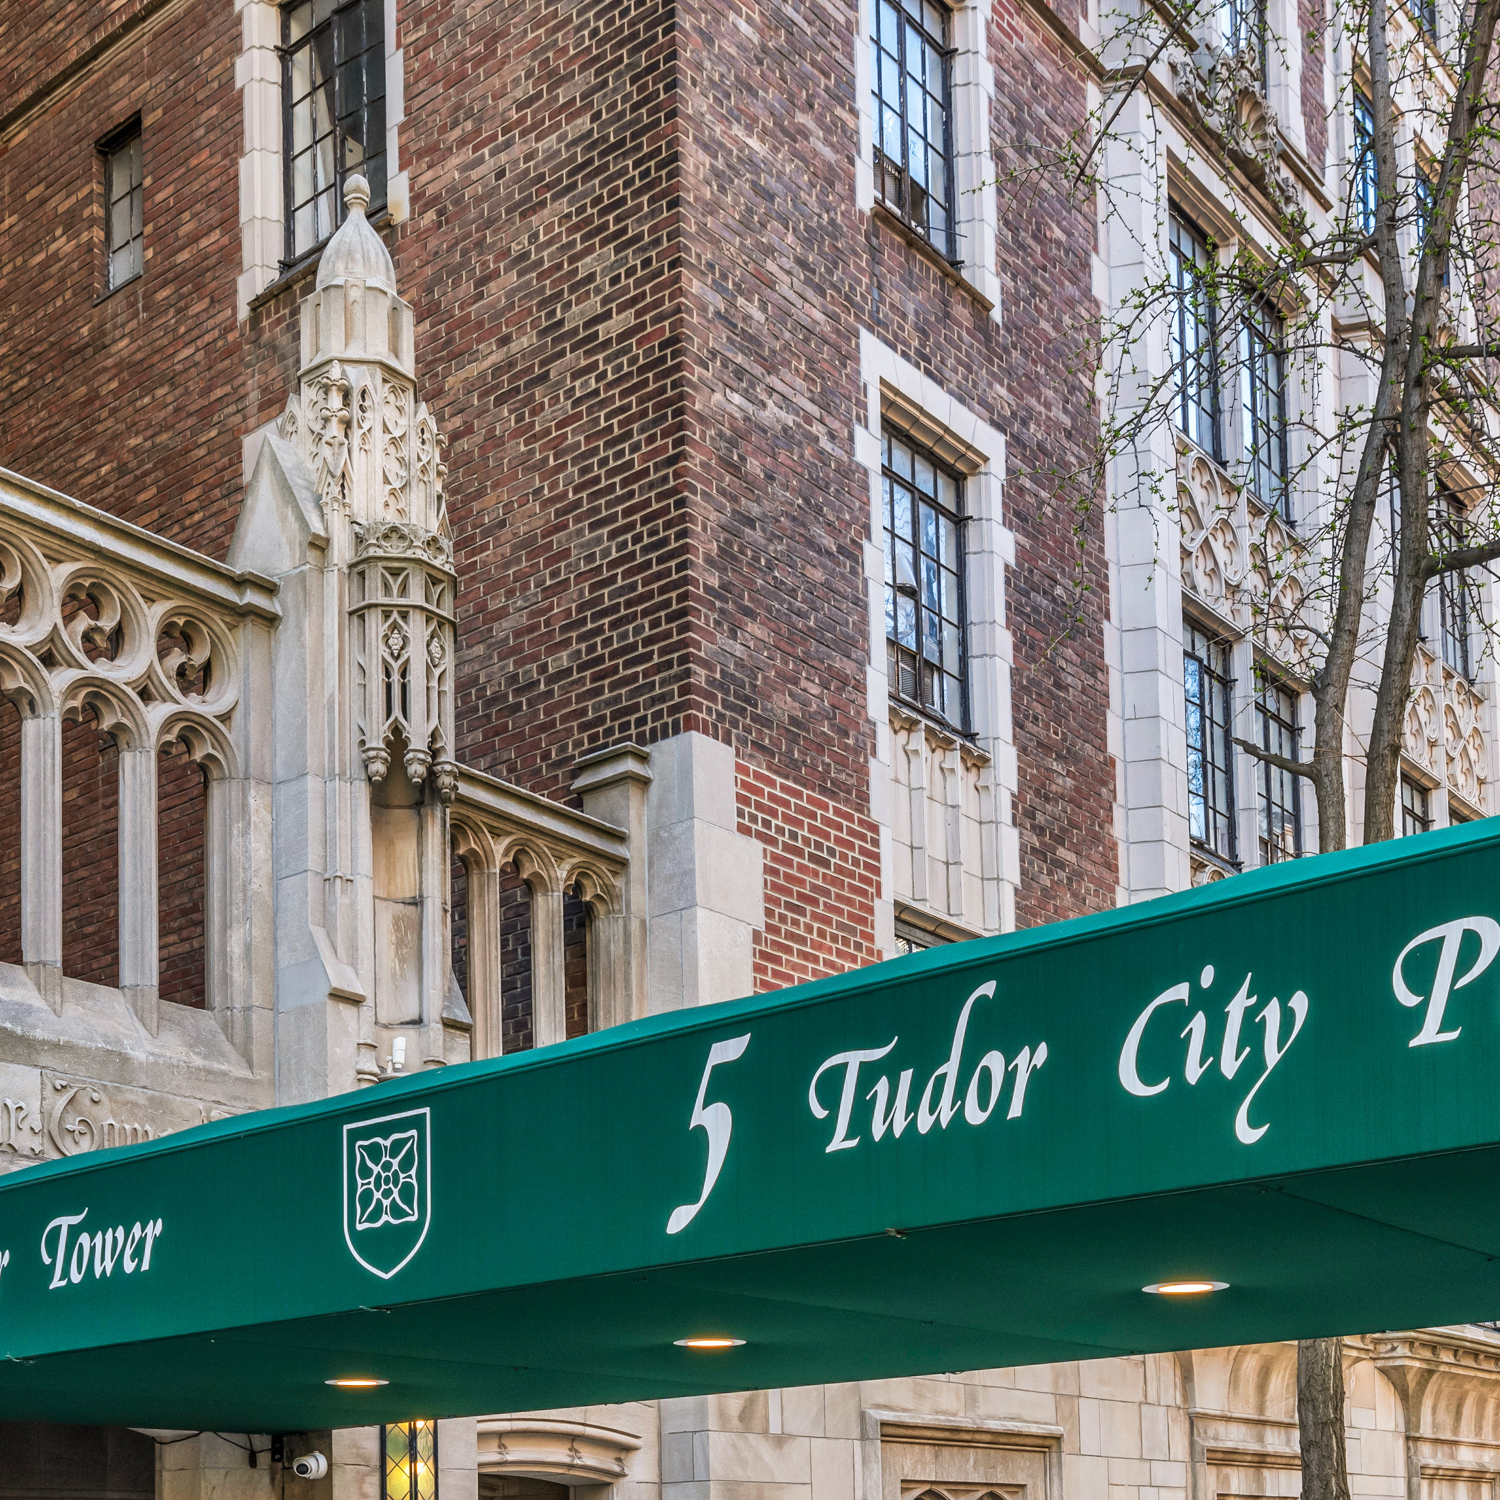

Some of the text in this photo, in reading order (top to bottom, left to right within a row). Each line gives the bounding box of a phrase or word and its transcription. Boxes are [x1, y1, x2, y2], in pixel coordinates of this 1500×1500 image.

[666, 1033, 751, 1234] 5
[808, 980, 1047, 1153] Tudor
[1118, 965, 1308, 1144] City
[41, 1207, 162, 1290] Tower
